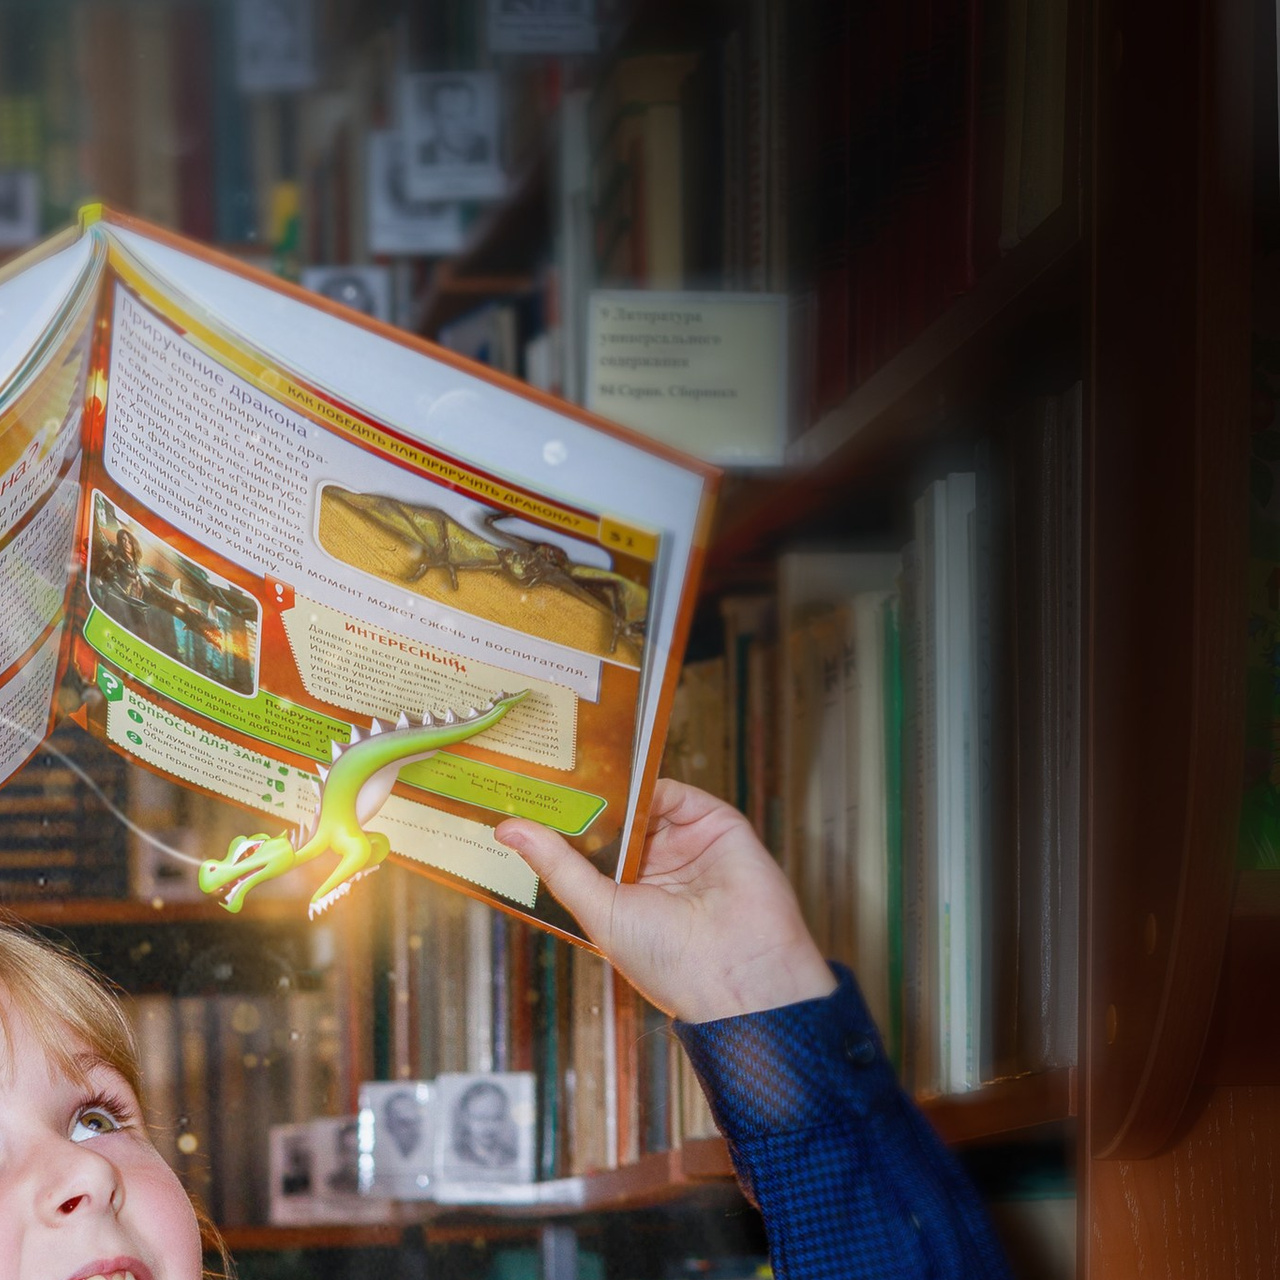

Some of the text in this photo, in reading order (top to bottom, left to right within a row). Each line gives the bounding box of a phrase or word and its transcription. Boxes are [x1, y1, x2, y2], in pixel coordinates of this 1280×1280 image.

[122, 295, 306, 438] Приручение дракона
[129, 399, 169, 440] Хагрид
[189, 446, 224, 474] книги
[221, 395, 292, 446] приручить
[148, 428, 237, 497] философский
[245, 440, 307, 482] момента
[253, 457, 307, 495] Именно
[286, 450, 309, 469] его
[288, 385, 580, 528] КАК ПОБЕДИТЬ ИЛИ ПРИРУЧИТЬ ДРАКОНА?
[143, 481, 220, 540] деревянную
[226, 535, 278, 573] хижину.
[198, 492, 226, 517] дело
[202, 482, 221, 500] что
[226, 497, 302, 545] воспитание
[112, 441, 587, 679] Огнедышащий змей любой момент может сжечь воспитателя,
[128, 694, 228, 753] ВОПРОСЫ ДЛЯ
